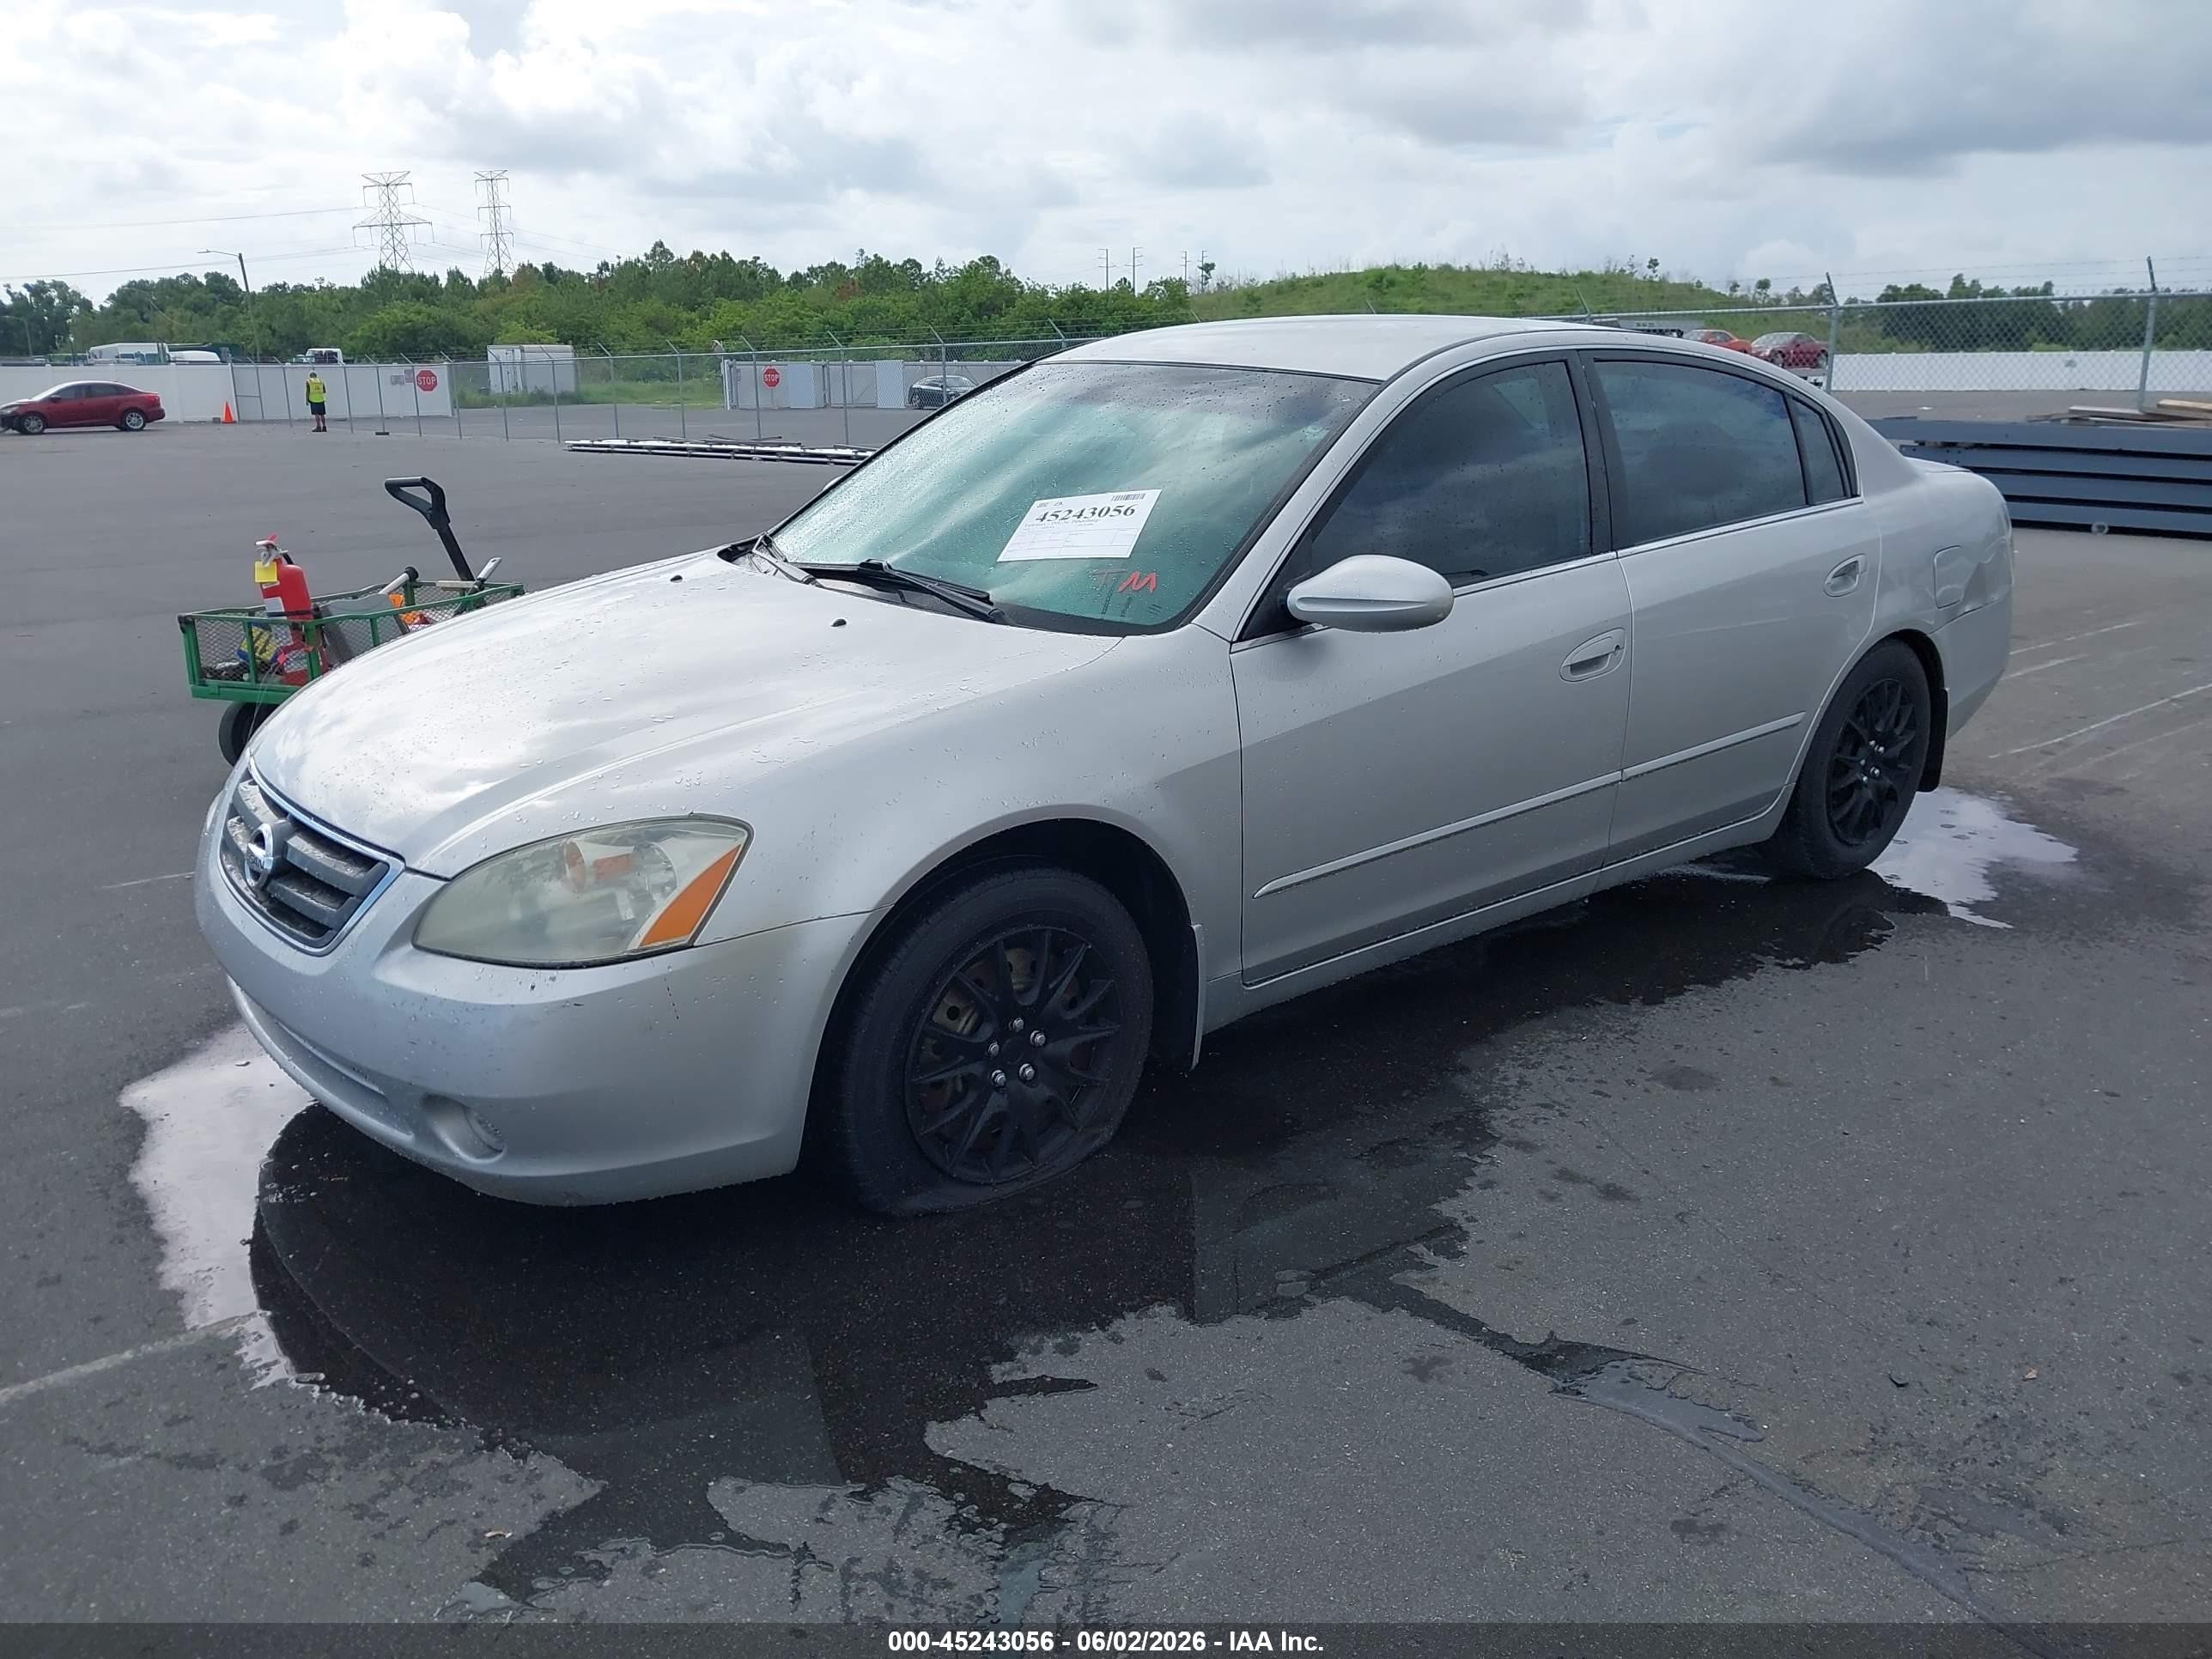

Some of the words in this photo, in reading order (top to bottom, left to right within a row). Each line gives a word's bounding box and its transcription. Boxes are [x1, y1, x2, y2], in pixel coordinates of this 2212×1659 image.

[417, 376, 436, 386] STOP
[765, 374, 779, 382] STOP
[1036, 504, 1137, 522] 45243056
